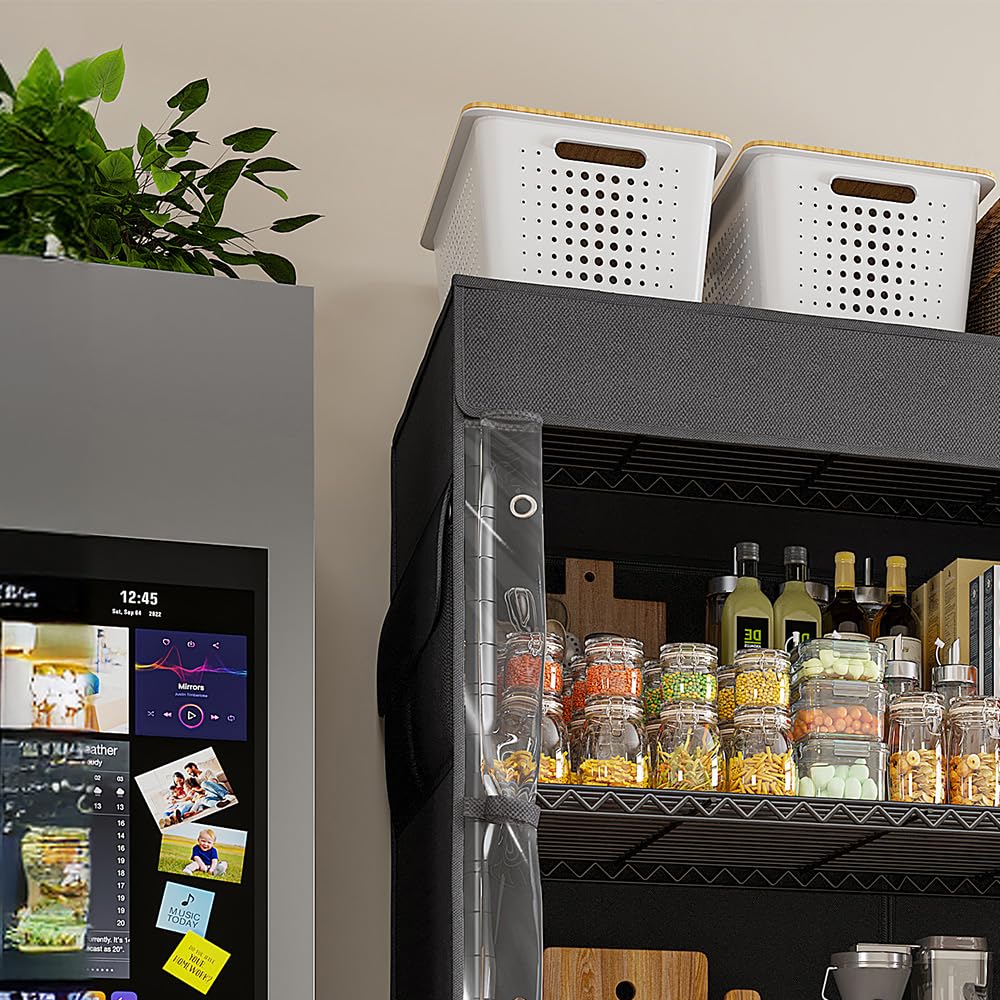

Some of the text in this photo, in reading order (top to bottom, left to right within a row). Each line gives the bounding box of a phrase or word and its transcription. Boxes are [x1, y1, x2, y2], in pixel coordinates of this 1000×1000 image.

[120, 590, 158, 606] 12:45
[178, 682, 205, 692] Mirrors
[84, 744, 118, 756] eather
[169, 906, 200, 921] MUSIC
[168, 914, 199, 928] TODAY
[189, 954, 204, 968] YOUR
[172, 955, 213, 984] HOMEWORK?
